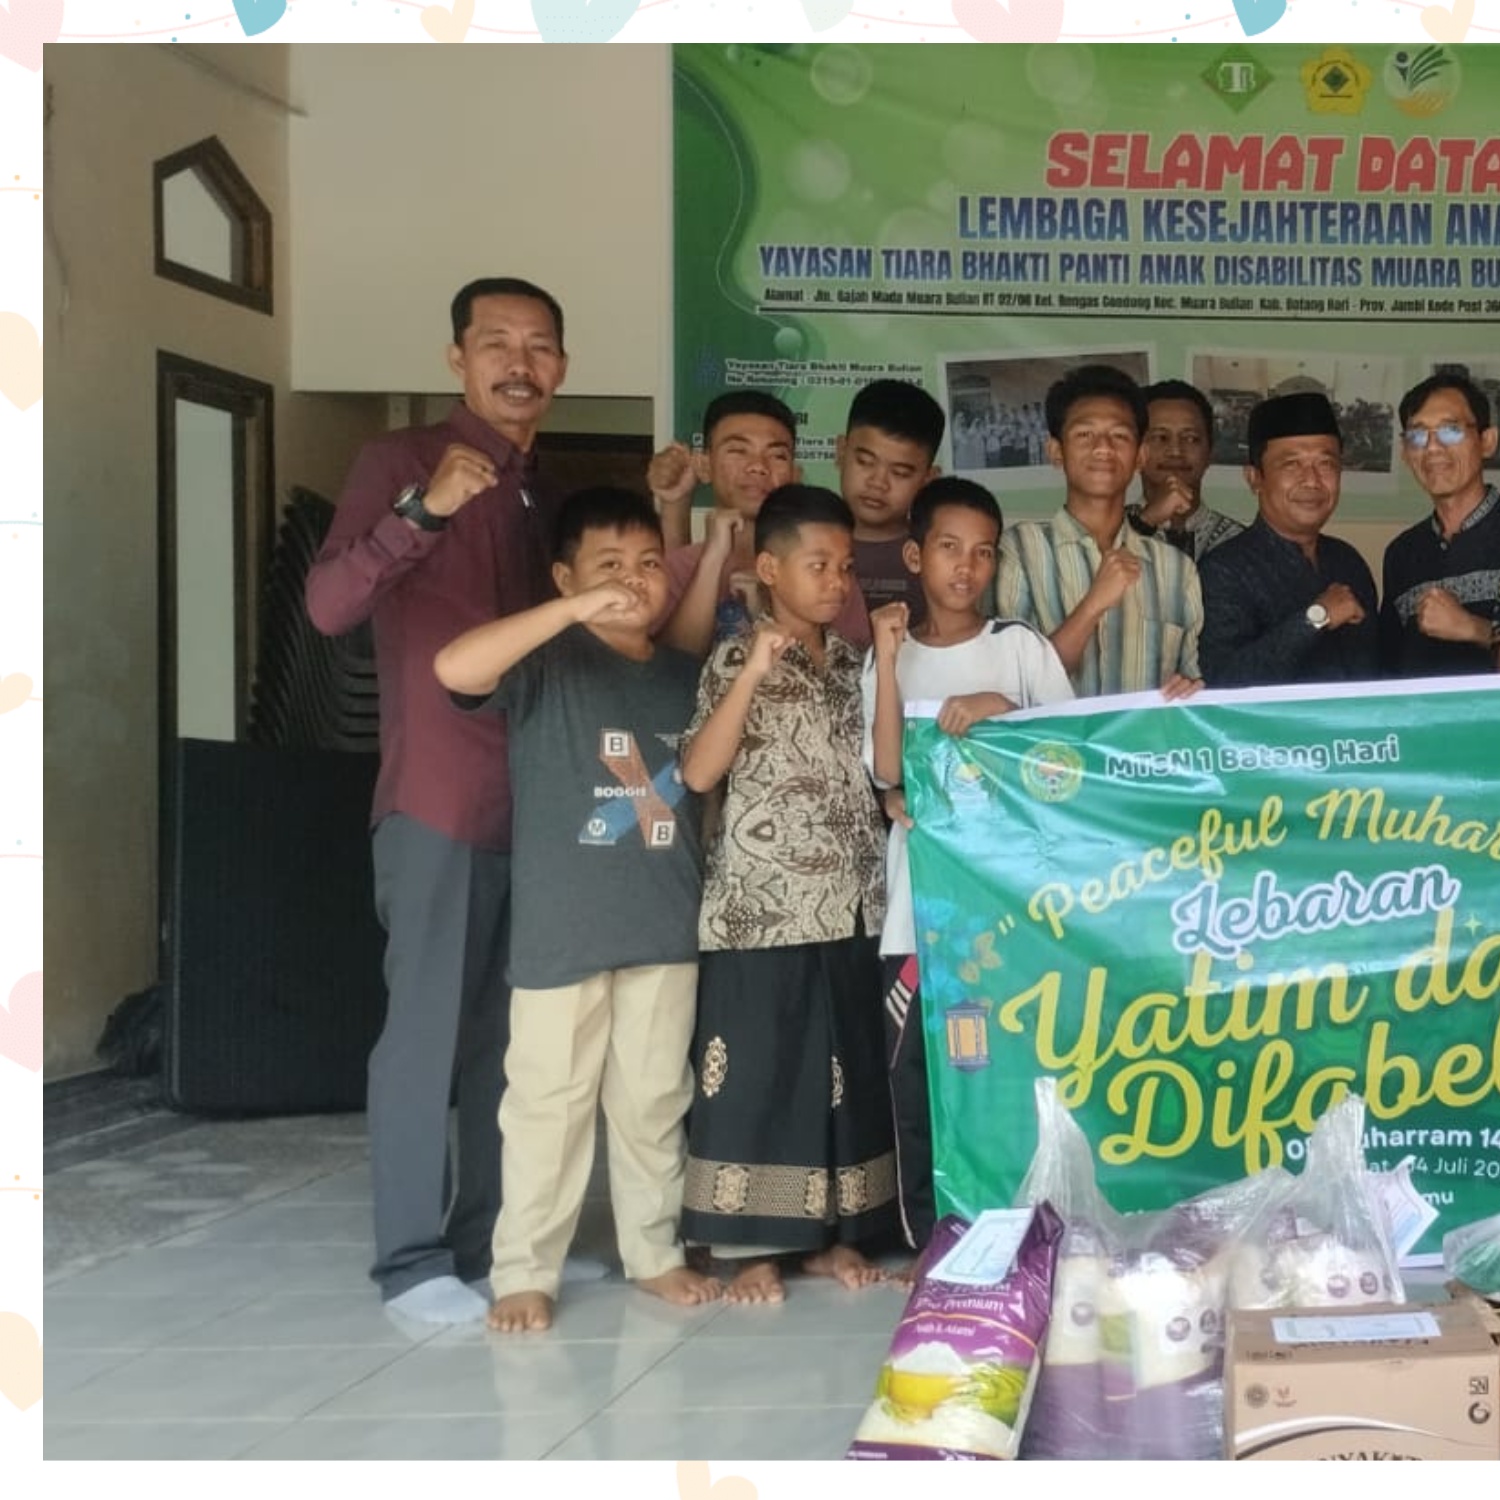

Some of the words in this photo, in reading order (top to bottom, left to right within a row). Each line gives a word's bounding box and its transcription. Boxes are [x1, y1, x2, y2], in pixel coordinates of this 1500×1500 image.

[1046, 131, 1344, 191] SELAMAT
[958, 196, 1129, 242] LEMBAGA
[1142, 199, 1433, 246] KESEJAHTERAAN
[759, 245, 871, 280] YAYASAN
[882, 248, 951, 281] TIARA
[961, 250, 1050, 284] BHAKTI
[1059, 252, 1130, 285] PANTI
[1139, 253, 1204, 285] ANAK
[1213, 255, 1362, 287] DISABILITAS
[1371, 257, 1461, 288] MUARA
[1106, 749, 1192, 777] MTsN
[1197, 746, 1214, 772] 1
[1218, 744, 1330, 771] Batang
[1333, 735, 1399, 764] Hari
[1173, 864, 1460, 957] Lebaran
[1000, 940, 1368, 1109] Yatim
[1362, 1127, 1472, 1149] uharram
[1433, 1157, 1469, 1175] Juli
